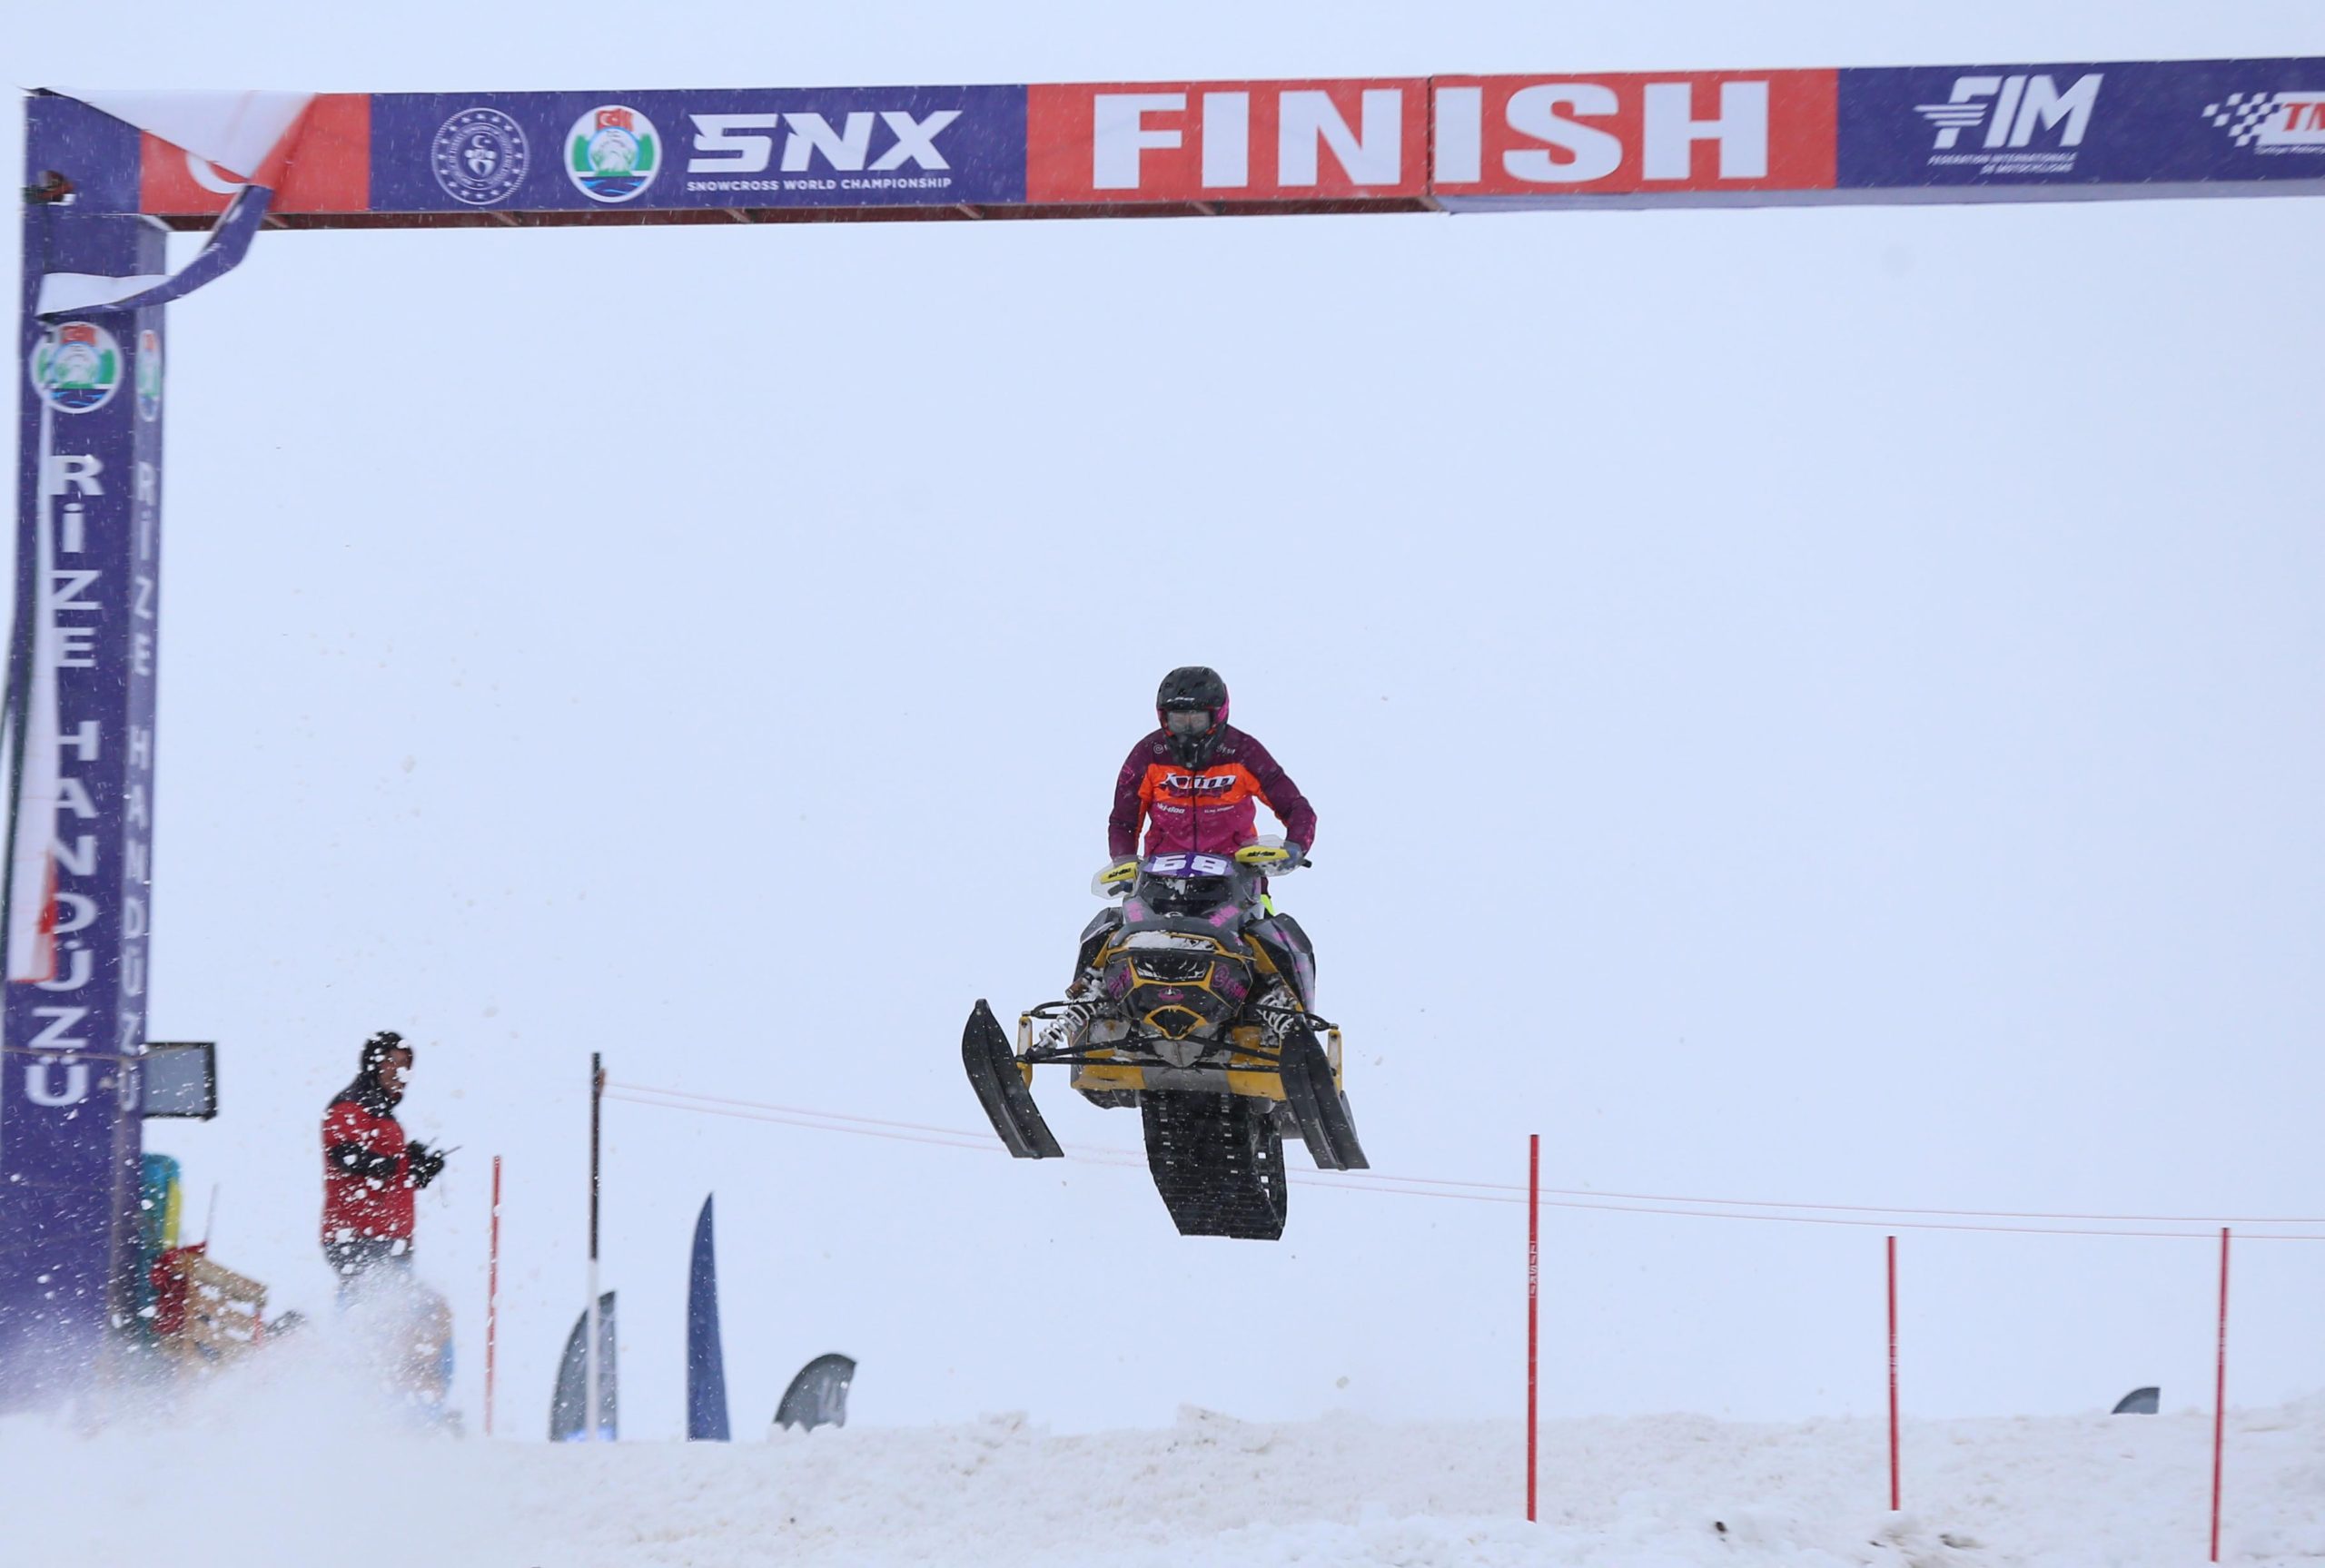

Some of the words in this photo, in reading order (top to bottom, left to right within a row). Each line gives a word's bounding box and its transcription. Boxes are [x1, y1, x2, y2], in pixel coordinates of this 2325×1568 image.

[687, 110, 963, 173] SNX
[1093, 80, 1769, 191] FINISH
[1914, 74, 2104, 149] FIM
[687, 180, 780, 192] SNOWCROSS
[783, 180, 837, 191] WORLD
[840, 177, 953, 190] CHAMPIONSHIP
[1152, 854, 1228, 875] 68
